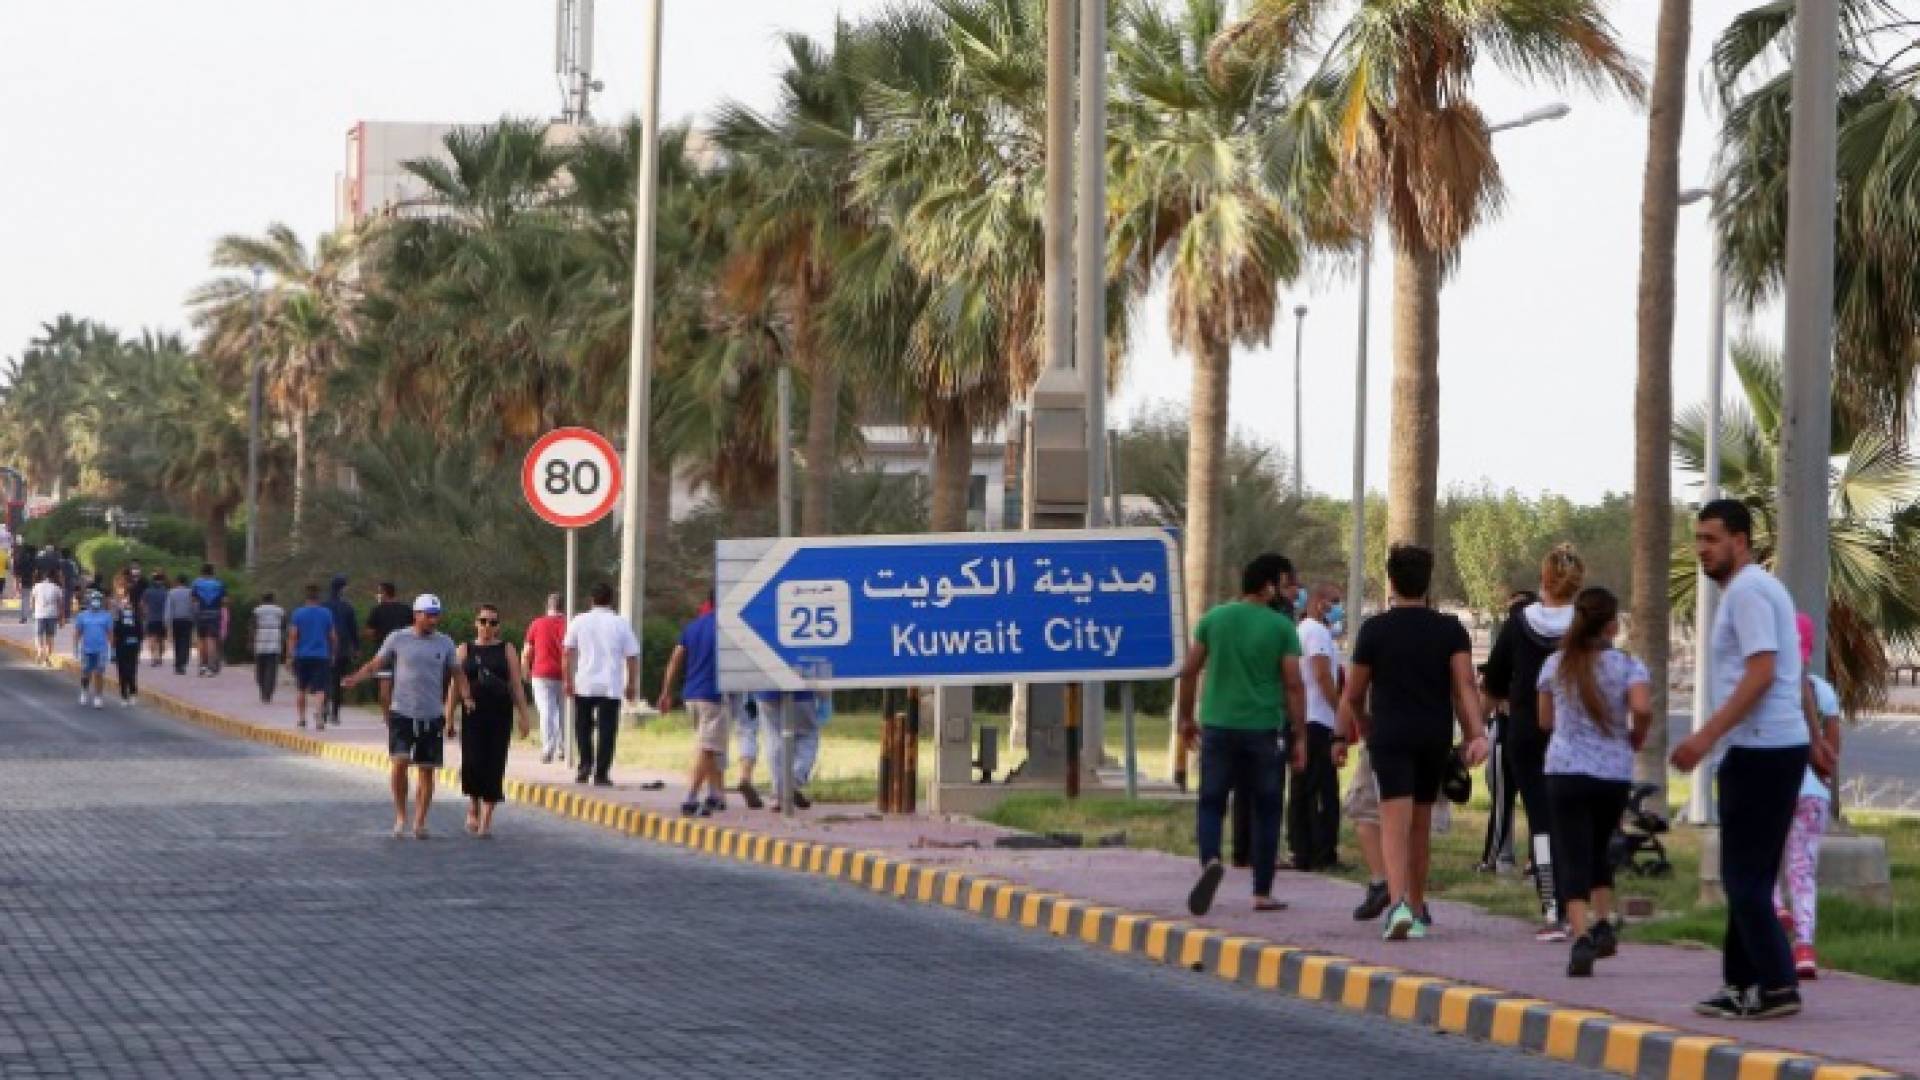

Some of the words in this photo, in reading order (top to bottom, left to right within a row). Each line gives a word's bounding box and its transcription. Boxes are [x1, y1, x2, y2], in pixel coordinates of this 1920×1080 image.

[545, 458, 600, 495] 80
[863, 556, 1016, 608] الكويت
[1034, 557, 1157, 603] مدينة
[790, 606, 838, 639] 25
[891, 619, 1024, 657] Kuwait
[1044, 617, 1124, 657] City
